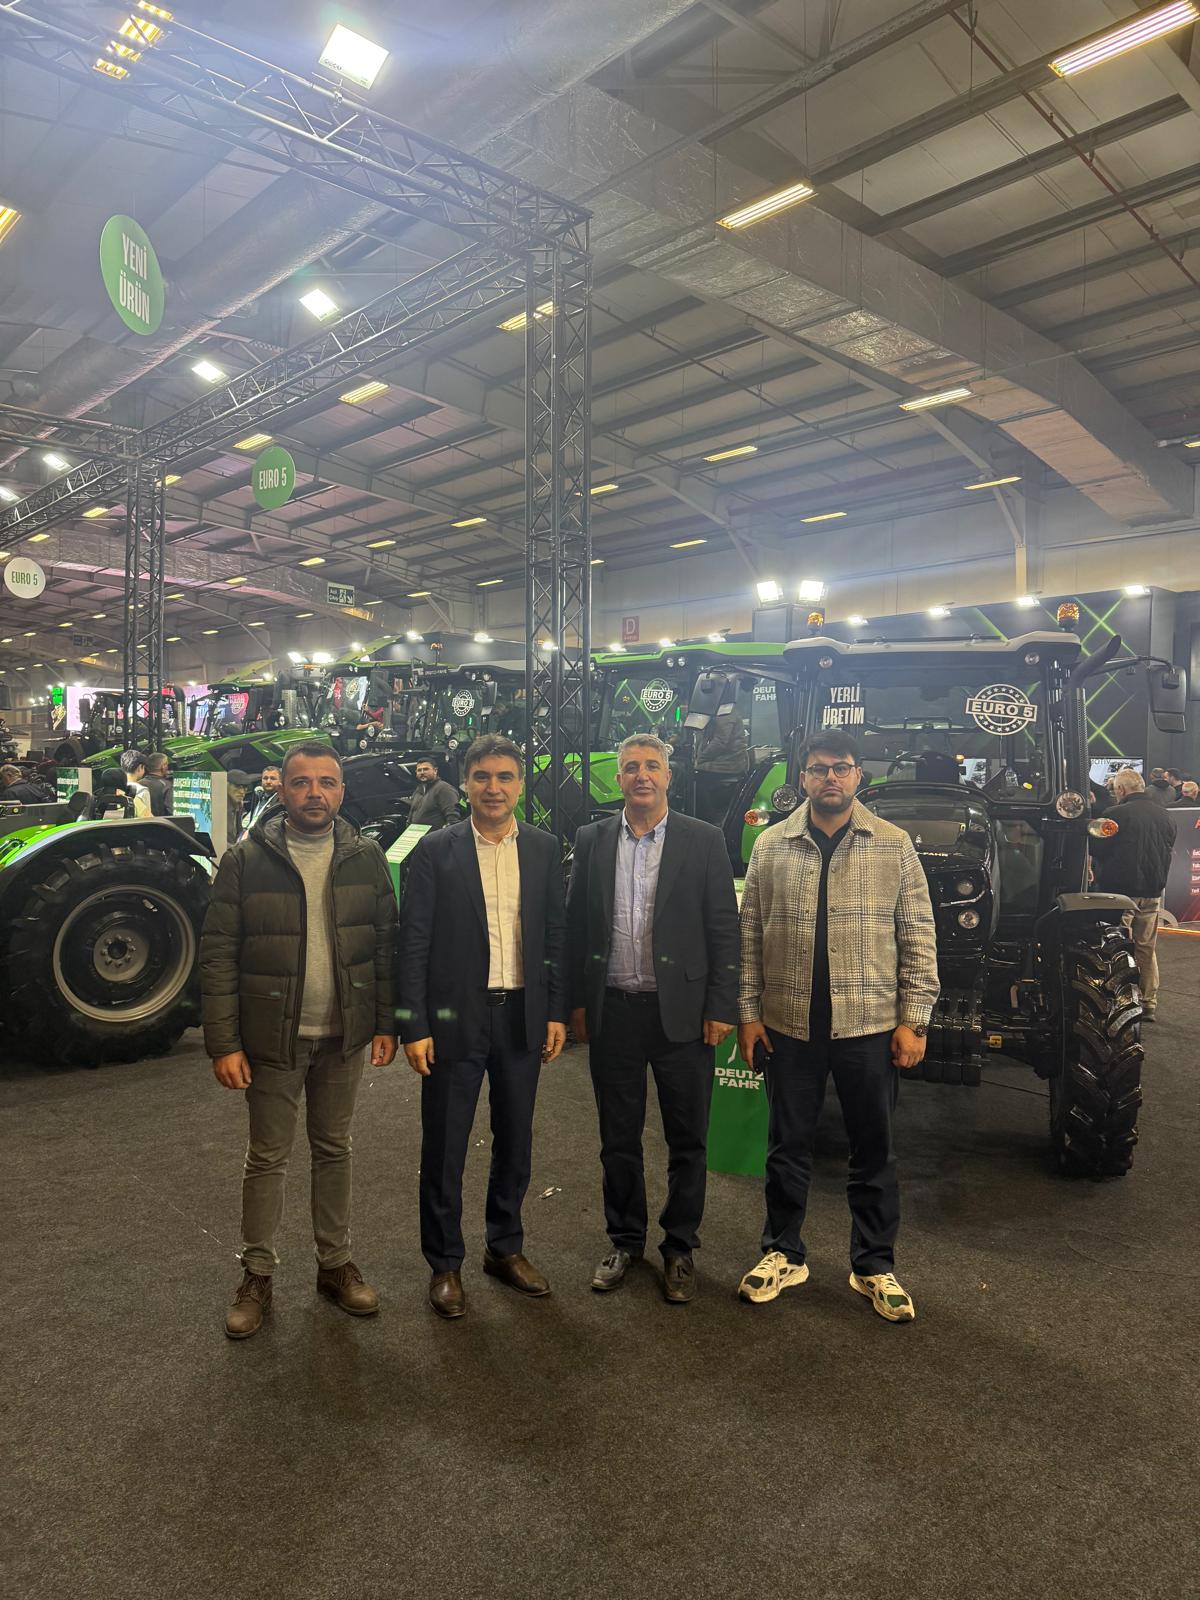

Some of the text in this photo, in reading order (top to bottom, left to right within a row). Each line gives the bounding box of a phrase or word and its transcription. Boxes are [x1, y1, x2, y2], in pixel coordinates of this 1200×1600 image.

[122, 232, 147, 281] YENİ
[119, 269, 150, 325] ÜRÜN
[259, 467, 287, 490] EURO 5
[11, 571, 38, 586] EURO 5
[626, 618, 636, 635] D
[642, 690, 671, 700] EURO 5
[753, 686, 776, 694] DEUT
[830, 682, 860, 704] YERLİ
[822, 704, 865, 726] ÜRETİM
[971, 701, 1034, 718] EURO 5
[714, 1067, 764, 1081] DEUTZ
[719, 1077, 760, 1090] FAHR
